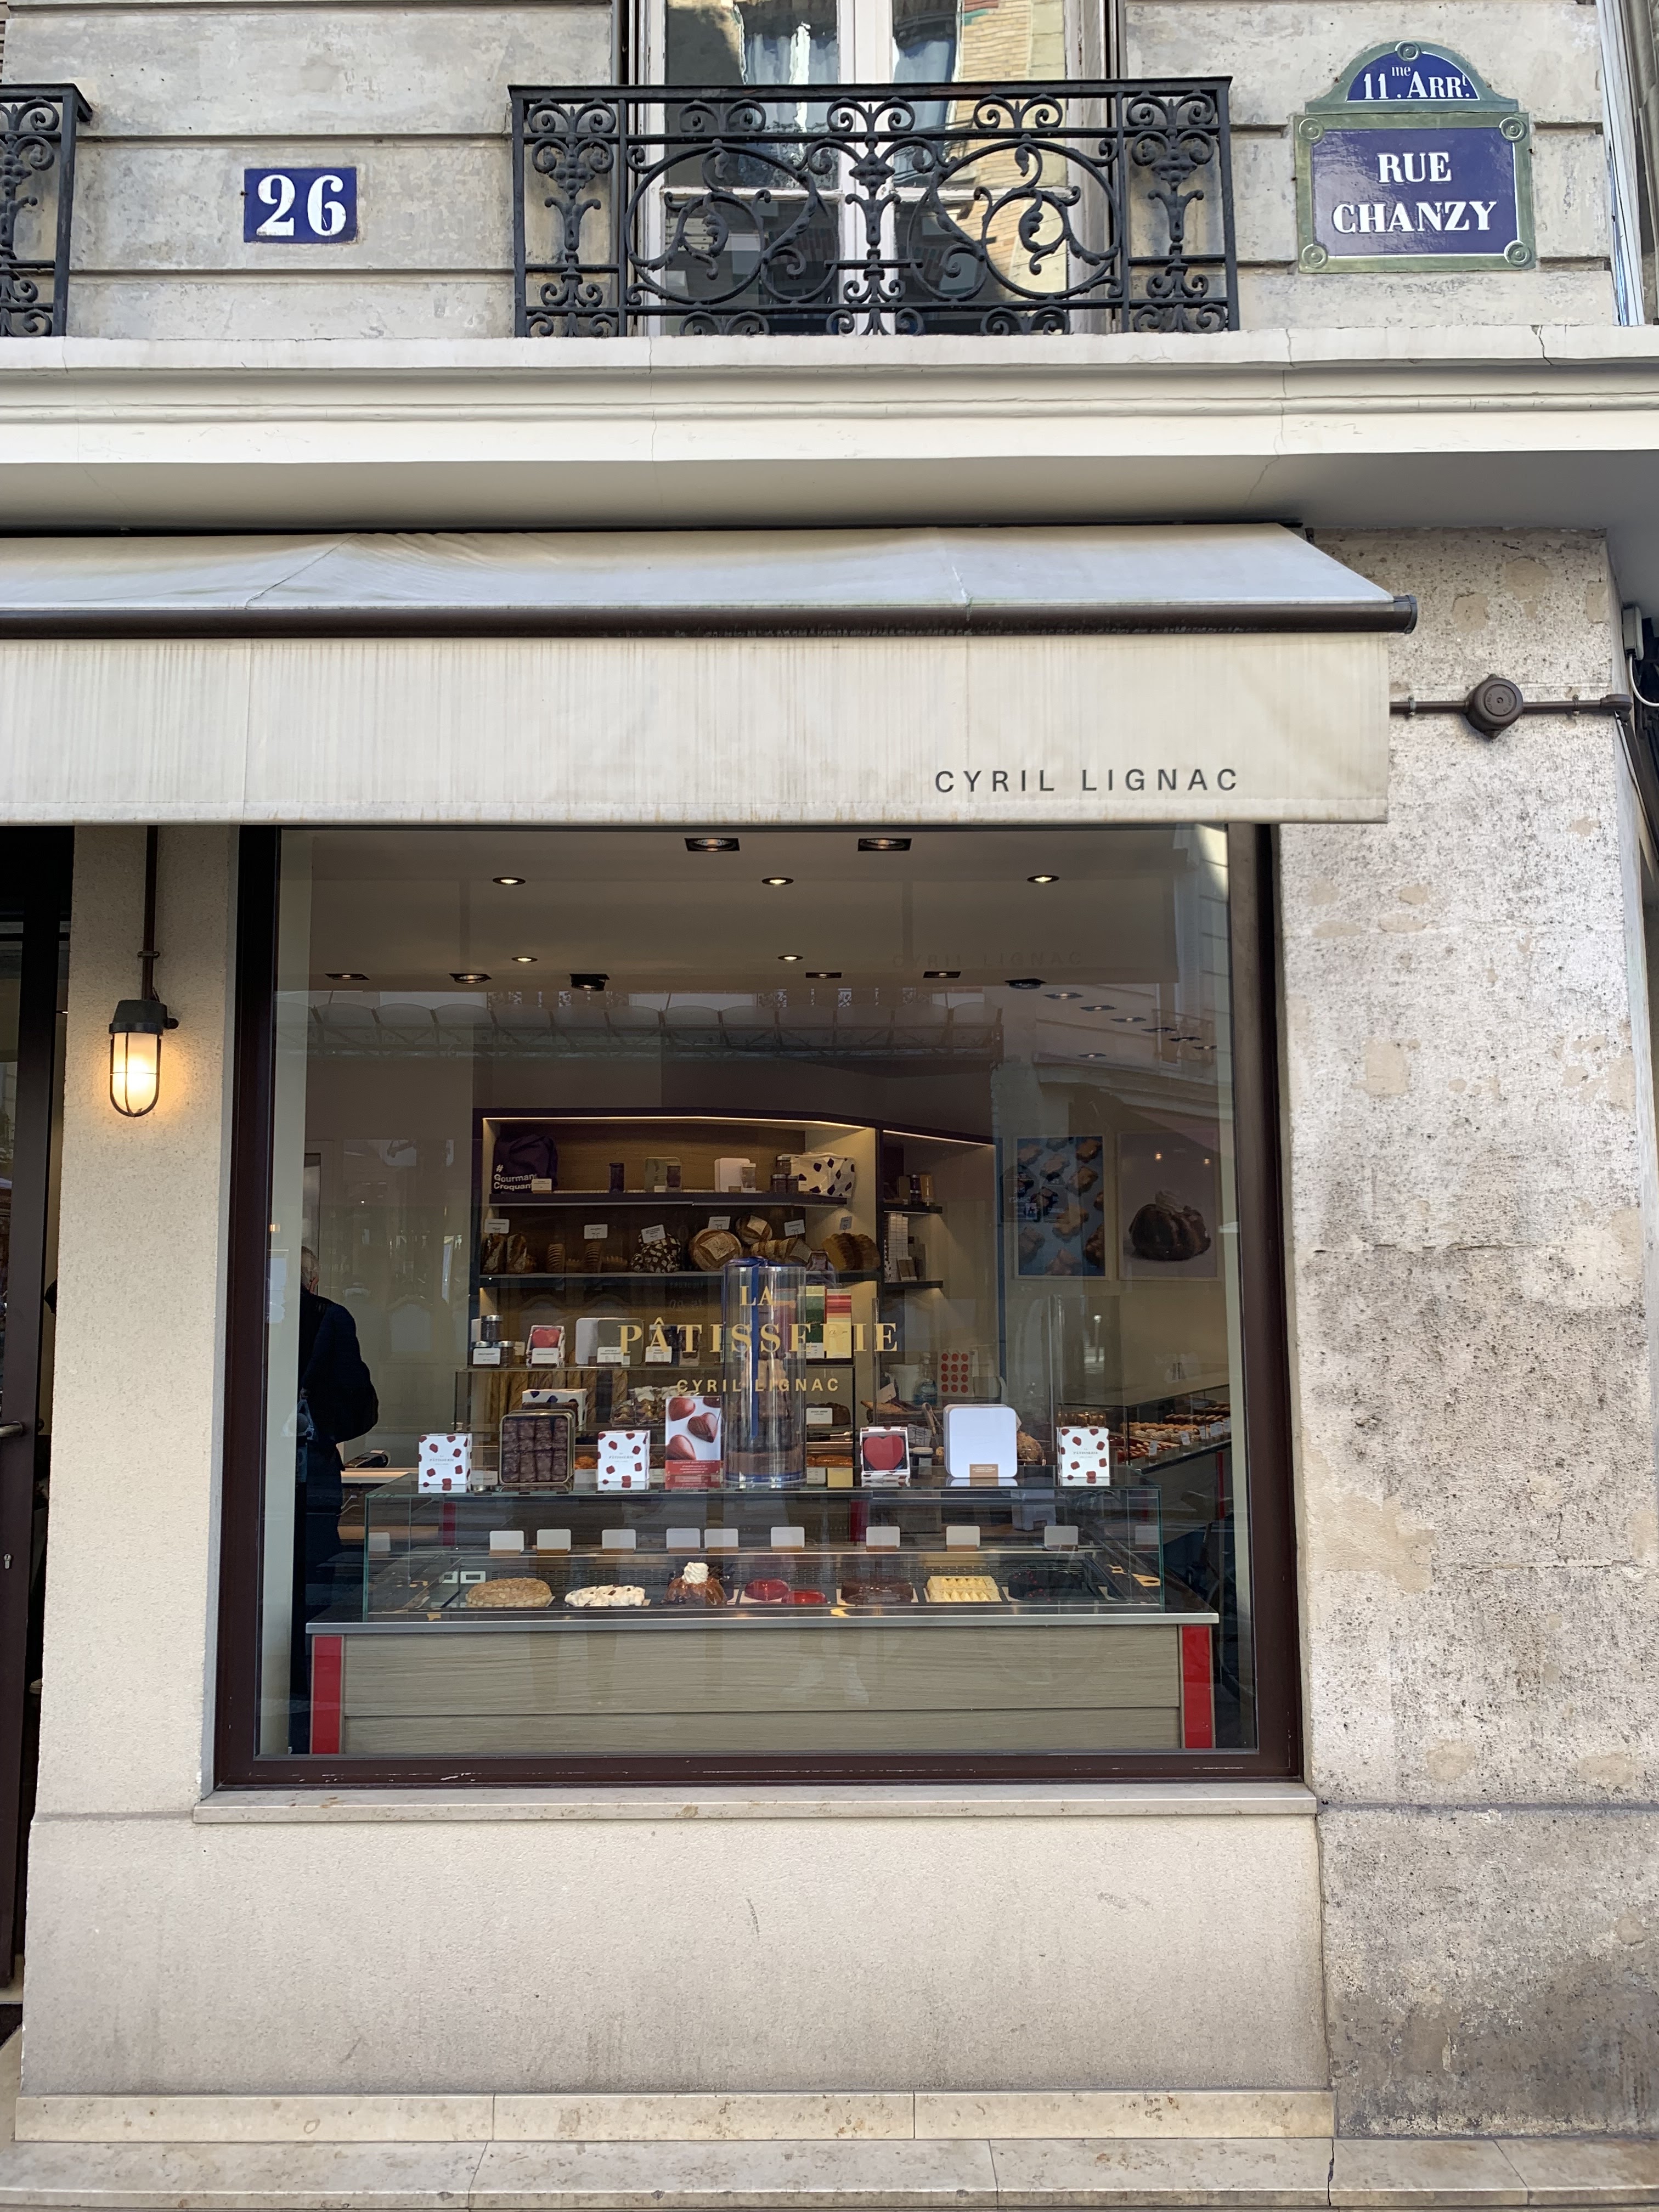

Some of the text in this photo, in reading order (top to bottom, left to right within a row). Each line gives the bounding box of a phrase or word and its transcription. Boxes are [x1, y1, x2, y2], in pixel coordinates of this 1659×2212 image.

[1378, 152, 1452, 183] RUE
[256, 174, 347, 236] 26
[1333, 201, 1497, 233] CHANZY
[935, 768, 1237, 793] CYRIL LIGNAC
[493, 1182, 532, 1191] Croquan
[740, 1285, 776, 1306] LA
[676, 1378, 839, 1393] CYRIL LIGNAC
